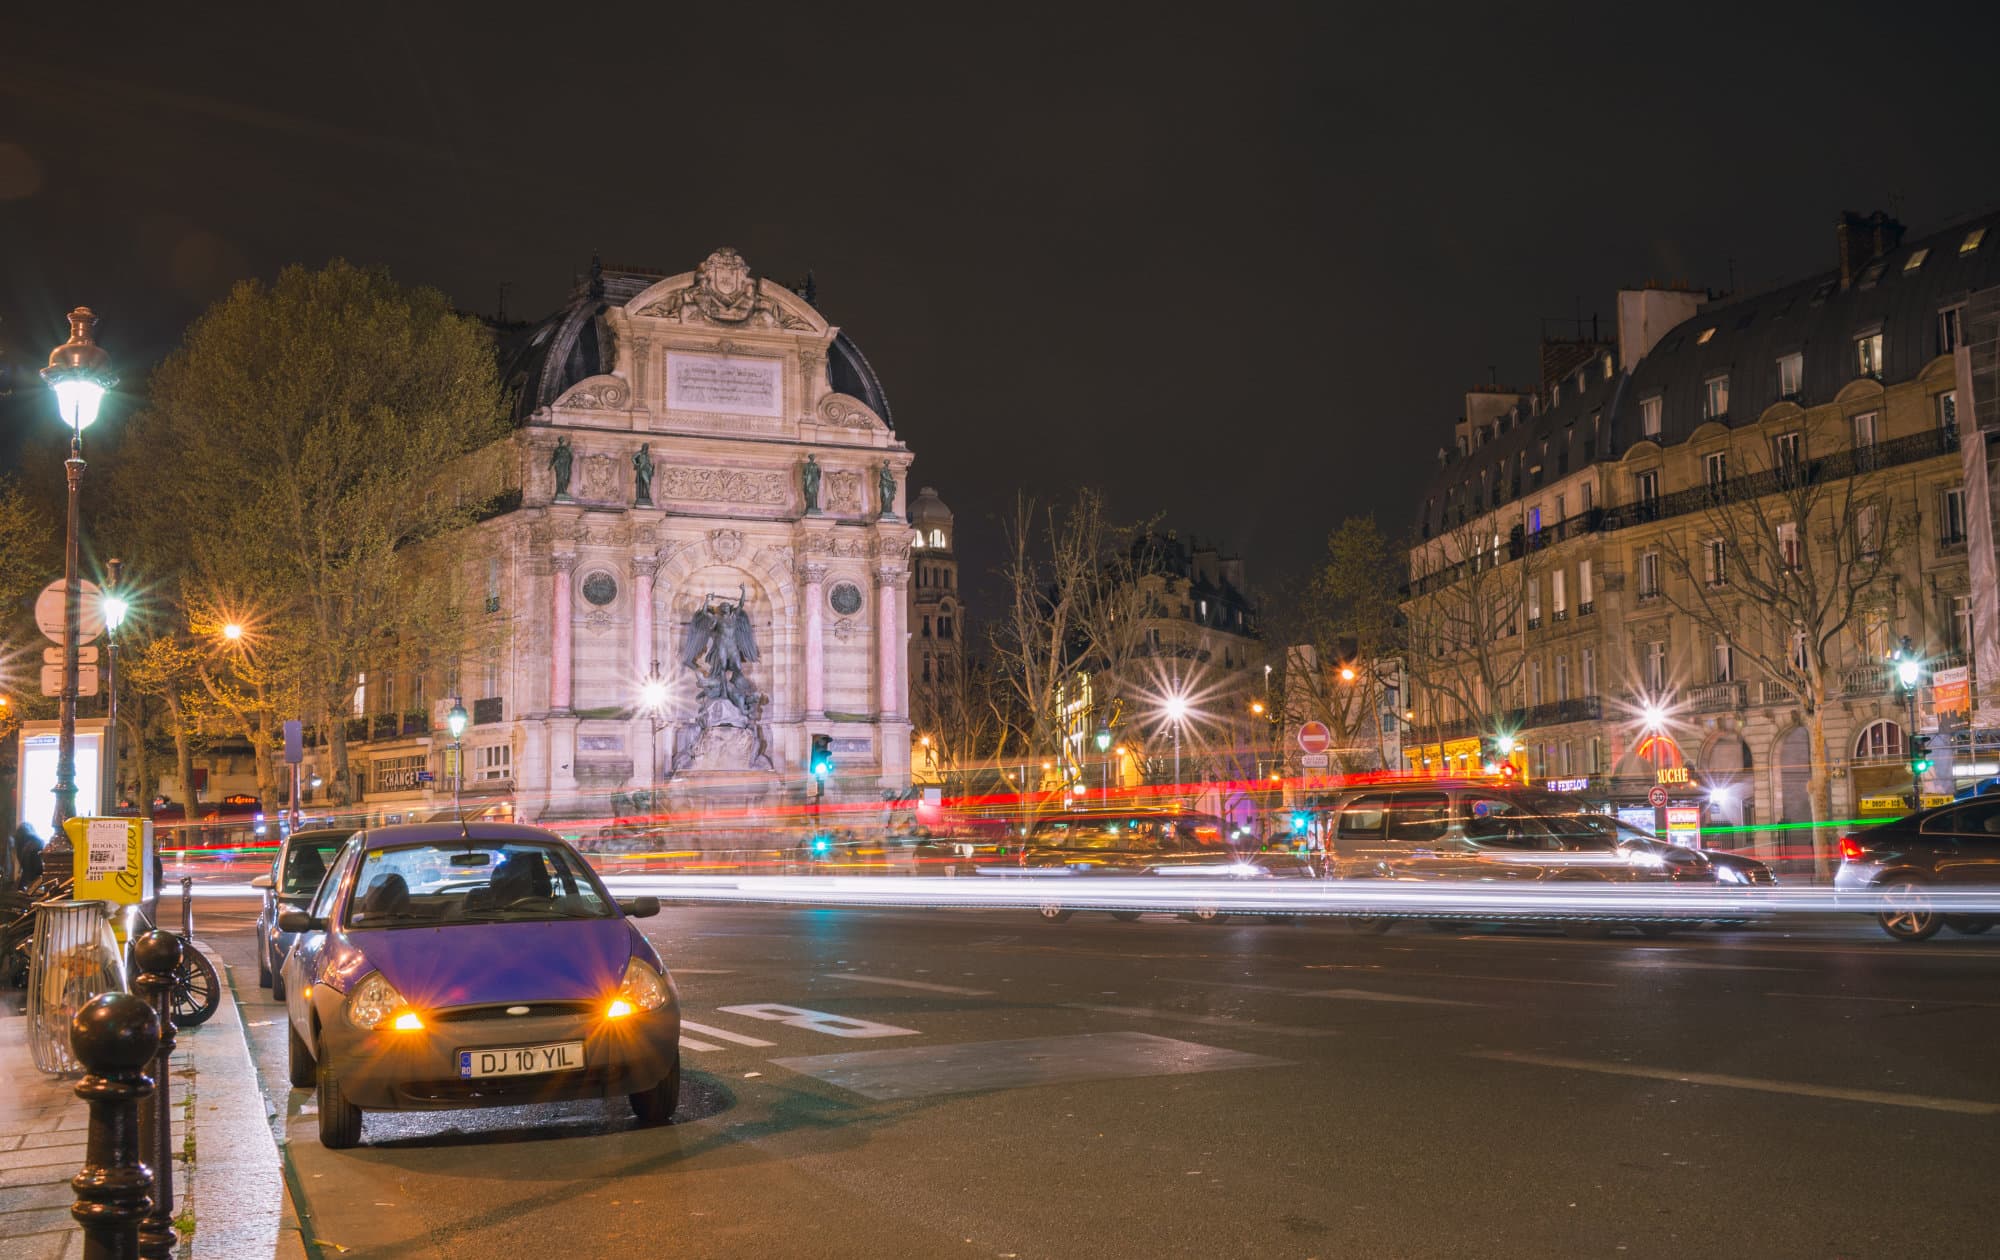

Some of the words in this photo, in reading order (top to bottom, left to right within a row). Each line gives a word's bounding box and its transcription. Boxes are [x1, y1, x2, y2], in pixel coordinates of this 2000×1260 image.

[385, 771, 415, 787] CHANGE
[1653, 792, 1664, 802] 30
[481, 1052, 508, 1074] DJ
[515, 1051, 534, 1071] 10
[543, 1046, 574, 1068] YIL
[461, 1067, 471, 1075] RO
